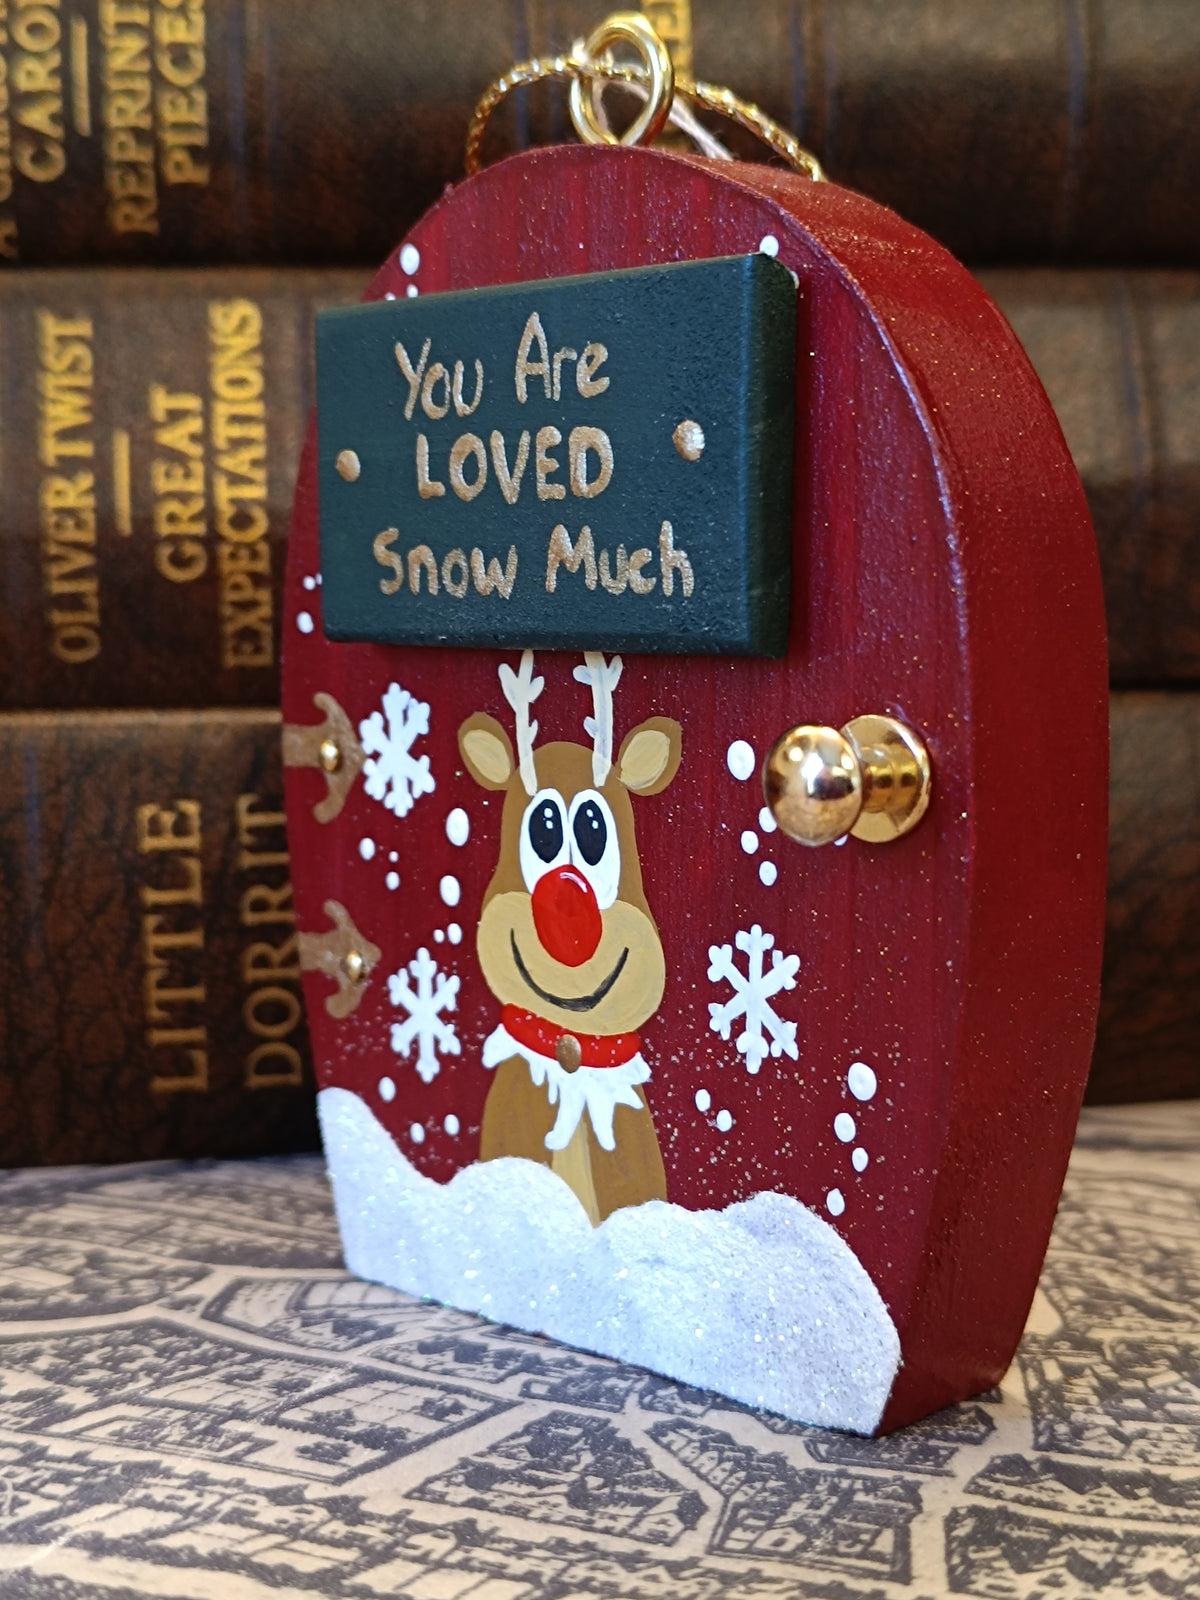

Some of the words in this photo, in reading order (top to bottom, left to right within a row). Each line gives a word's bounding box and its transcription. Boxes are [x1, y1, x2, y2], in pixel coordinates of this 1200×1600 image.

[9, 0, 66, 183] CARO
[154, 0, 210, 187] PIECE
[36, 308, 95, 468] TWIST
[395, 338, 483, 421] You
[515, 312, 610, 404] Are
[150, 383, 208, 583] GREAT
[207, 298, 275, 668] EXPECTATIONS
[416, 425, 614, 504] LOVED
[41, 470, 101, 664] OLIVER
[373, 527, 518, 600] Snow
[545, 520, 695, 598] Much
[136, 799, 209, 1094] LITTLE
[235, 793, 303, 1089] DORRIT
